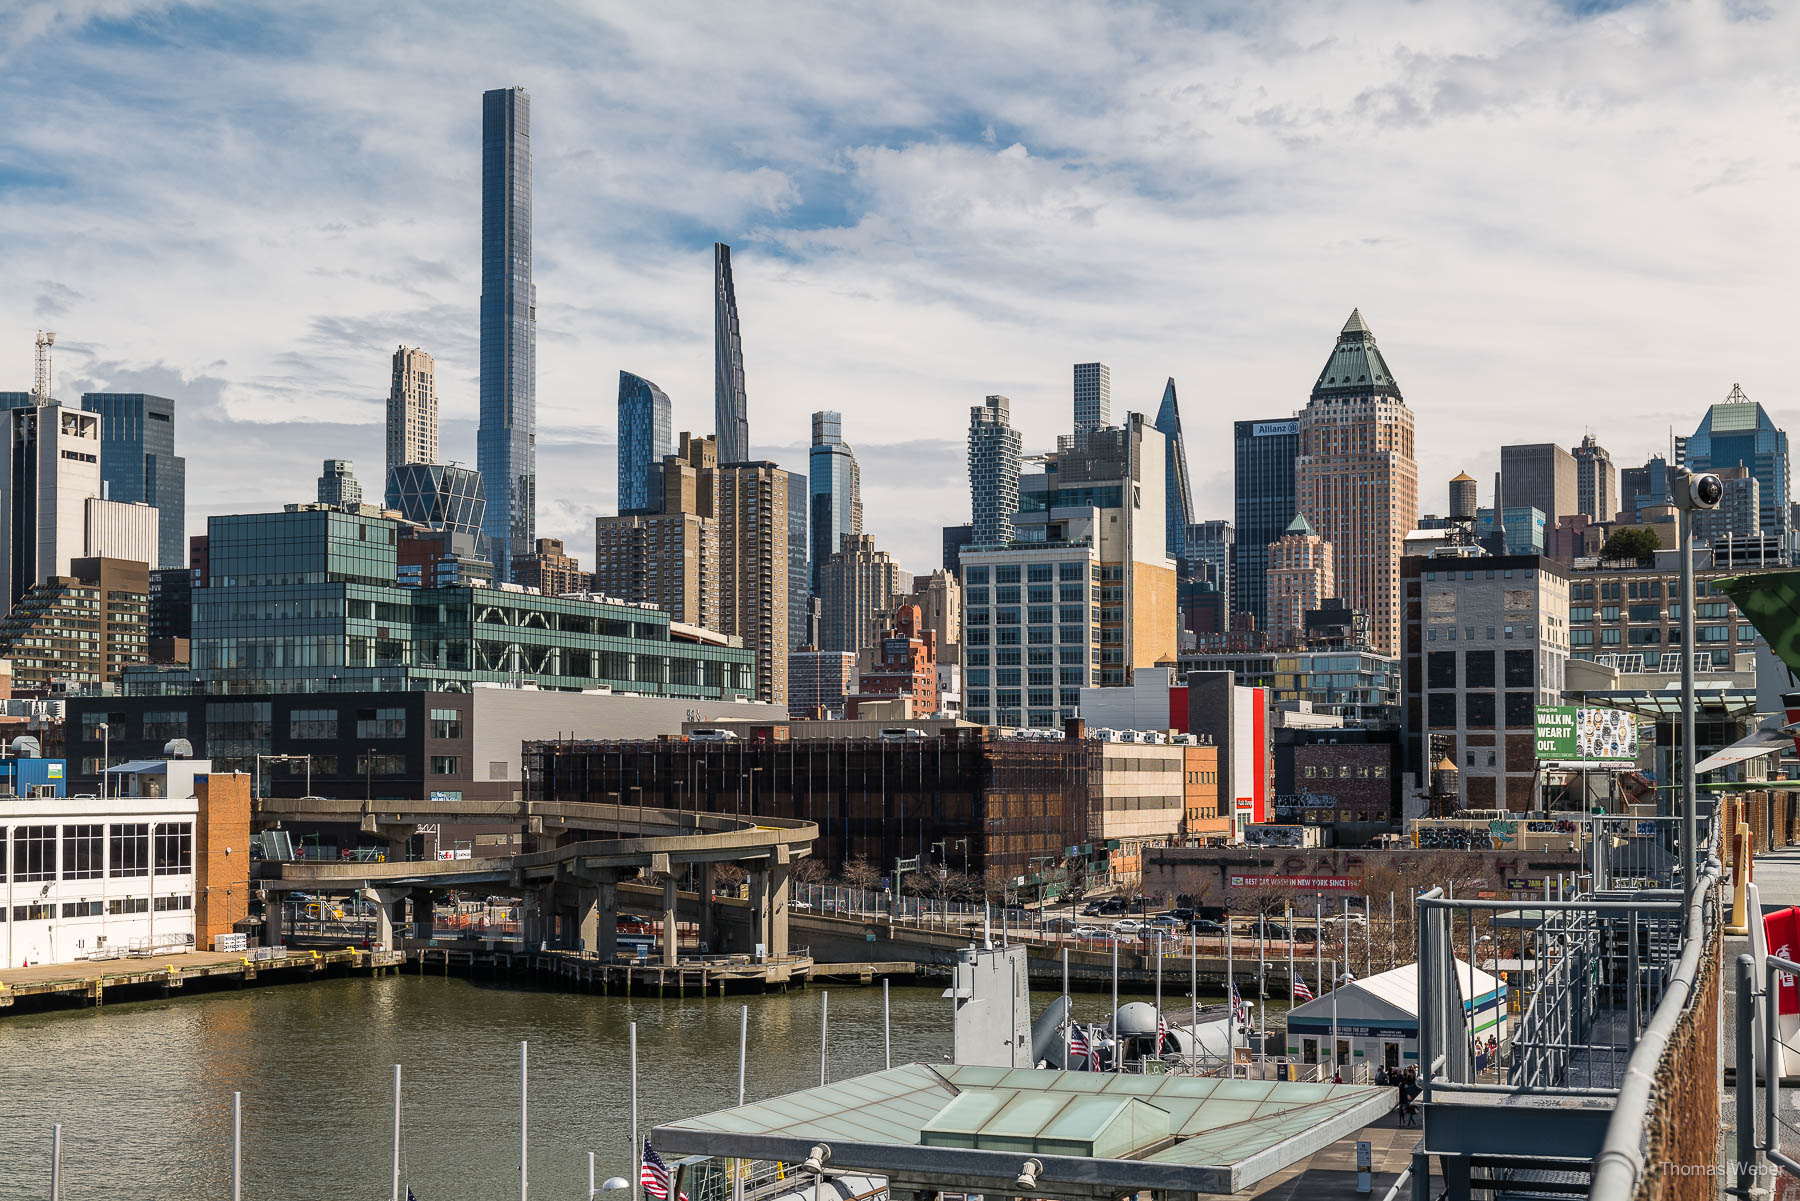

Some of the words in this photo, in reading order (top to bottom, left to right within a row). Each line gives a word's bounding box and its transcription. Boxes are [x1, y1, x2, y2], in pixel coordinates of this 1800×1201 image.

[1259, 425, 1287, 433] Allianz
[1537, 714, 1561, 724] WALK
[1562, 714, 1574, 726] IN,
[1537, 728, 1562, 738] WEAR
[1563, 728, 1571, 738] IT
[1538, 741, 1556, 751] OUT.
[1245, 878, 1257, 886] BEST
[1259, 878, 1270, 886] CAR
[1297, 879, 1311, 887] NEW
[1311, 879, 1328, 887] YORK
